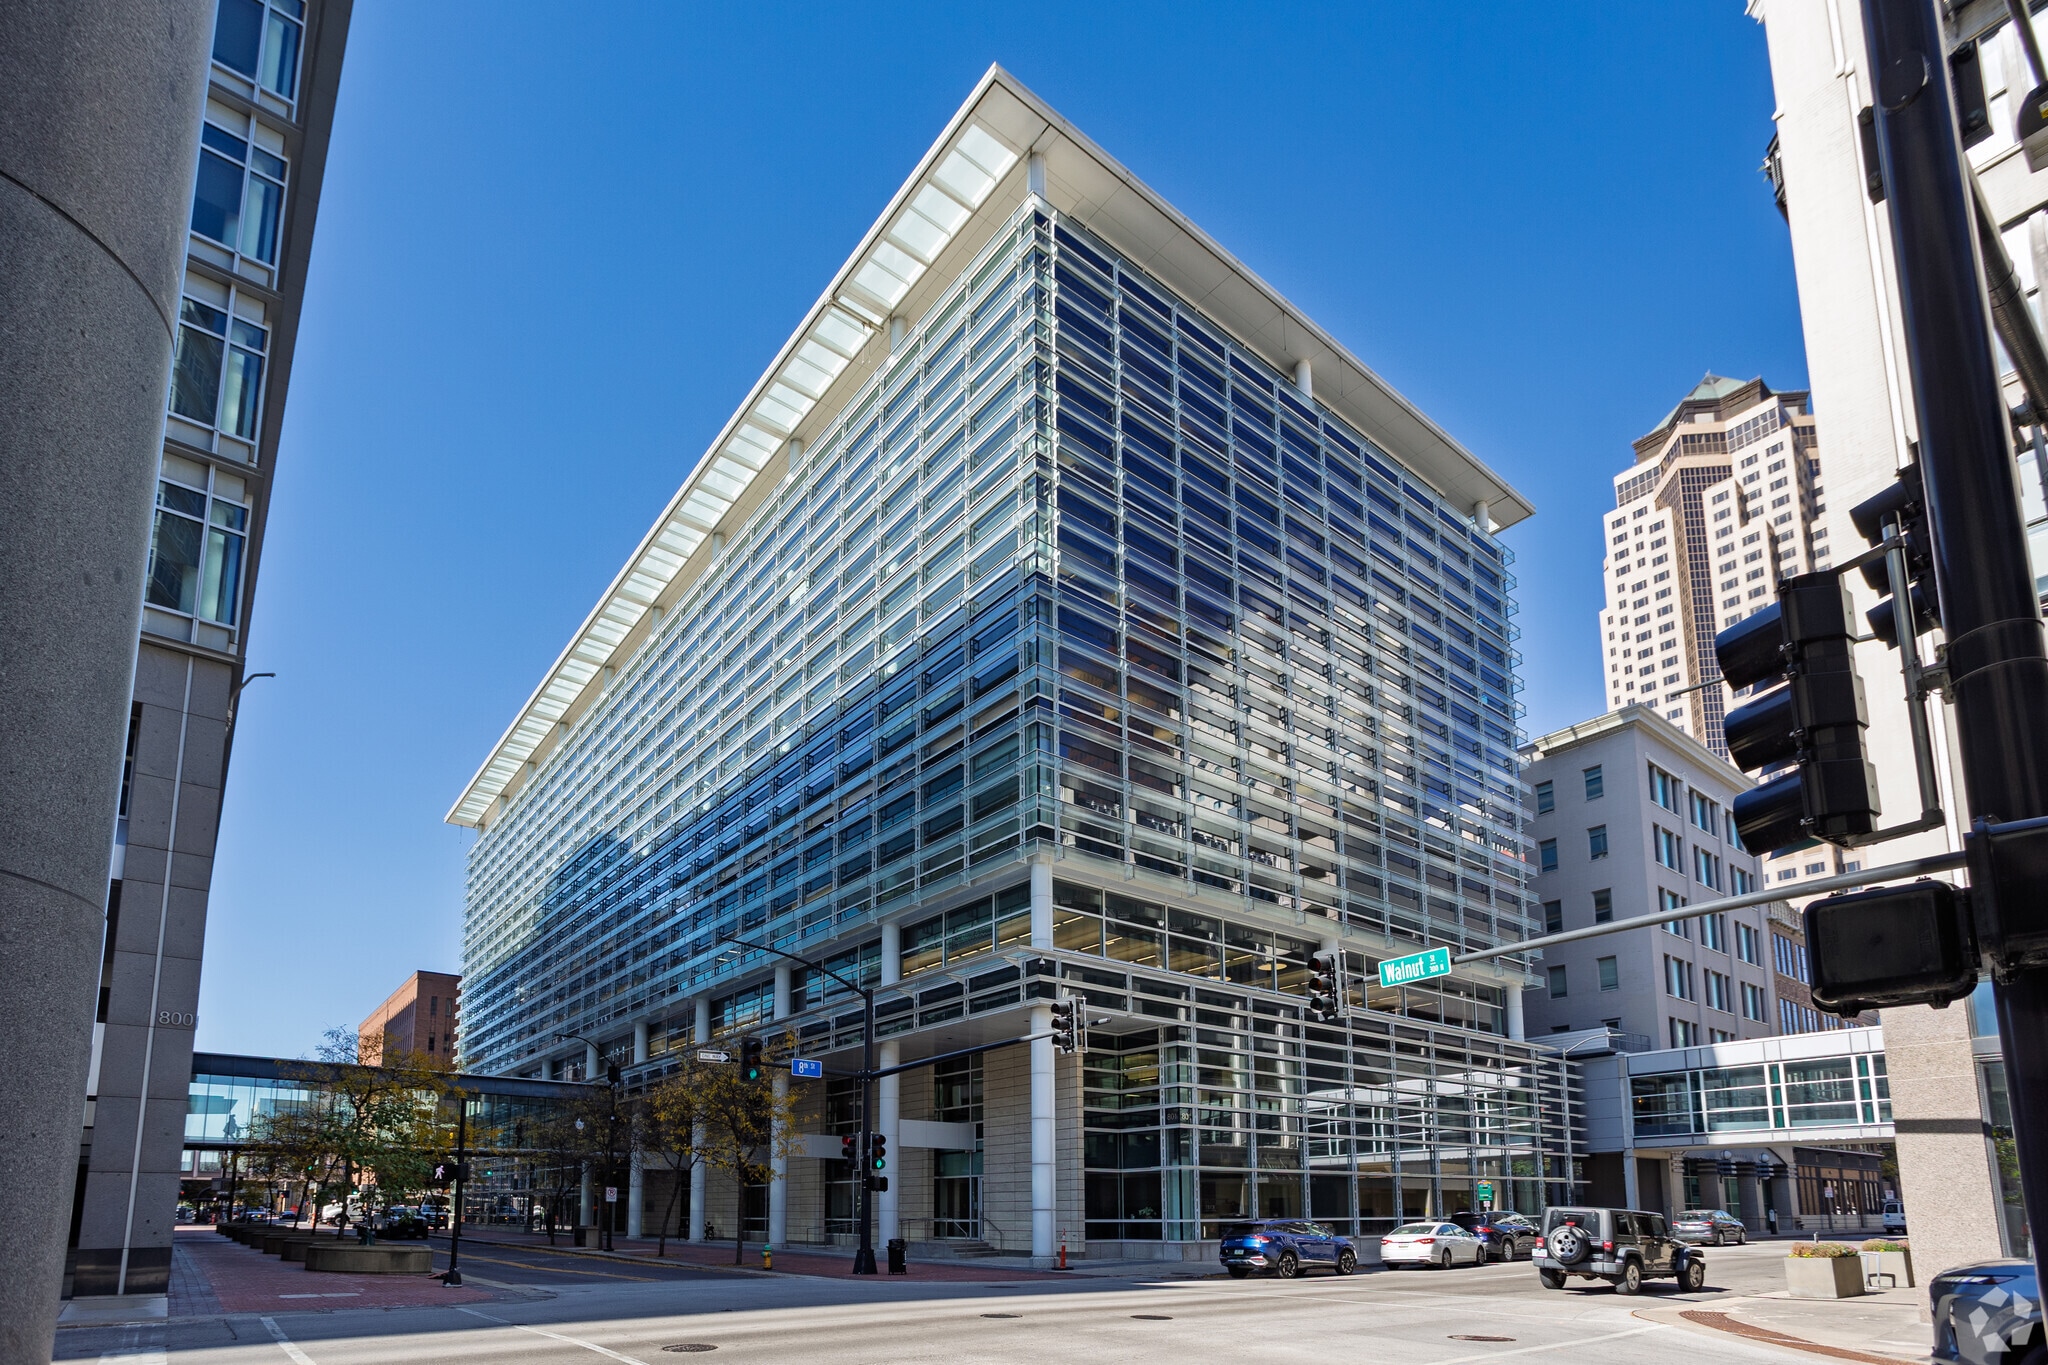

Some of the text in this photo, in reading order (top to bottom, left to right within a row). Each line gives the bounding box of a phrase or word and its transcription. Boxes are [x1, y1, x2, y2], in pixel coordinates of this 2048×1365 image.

[1384, 957, 1425, 983] Walnut
[159, 1011, 194, 1026] 800
[798, 1061, 809, 1074] 8th
